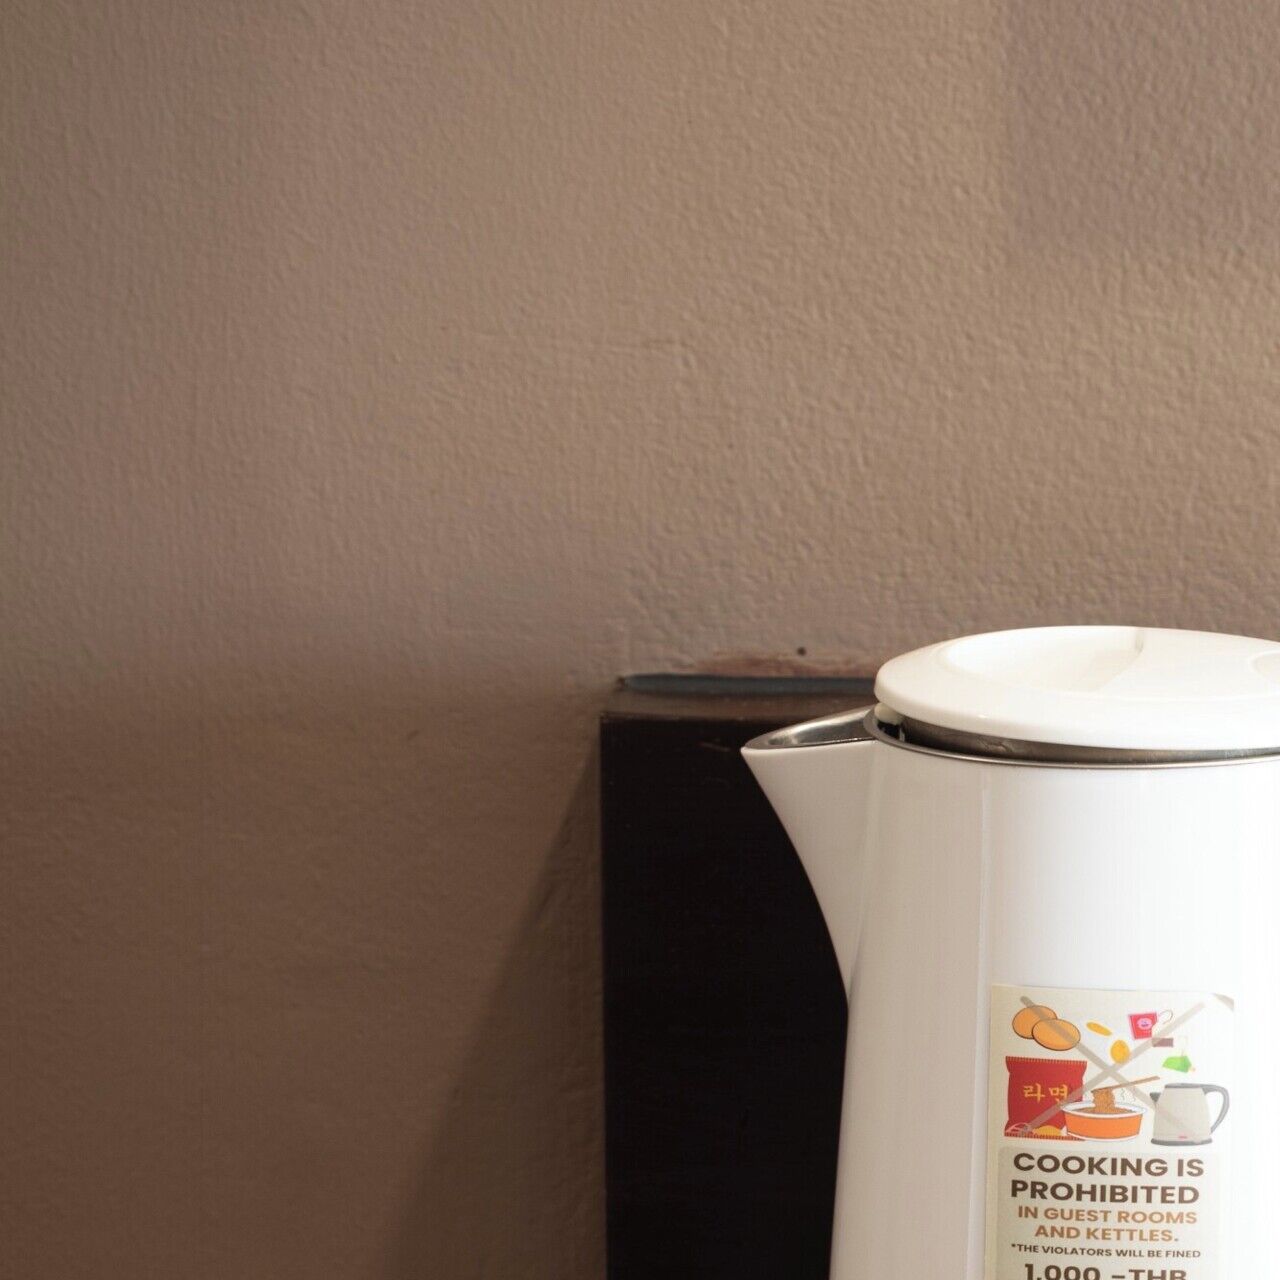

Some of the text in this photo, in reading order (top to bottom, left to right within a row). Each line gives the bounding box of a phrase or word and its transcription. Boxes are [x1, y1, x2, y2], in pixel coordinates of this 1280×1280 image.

[1013, 1152, 1205, 1177] COOKING IS
[1010, 1179, 1200, 1204] PROHIBITED
[1018, 1205, 1198, 1224] IN GUEST ROOMS
[1034, 1225, 1179, 1242] AND KETTLES.
[1041, 1245, 1113, 1257] VIOLATORS
[1115, 1248, 1145, 1258] WILL
[1147, 1249, 1162, 1258] BE
[1165, 1249, 1201, 1258] FINED
